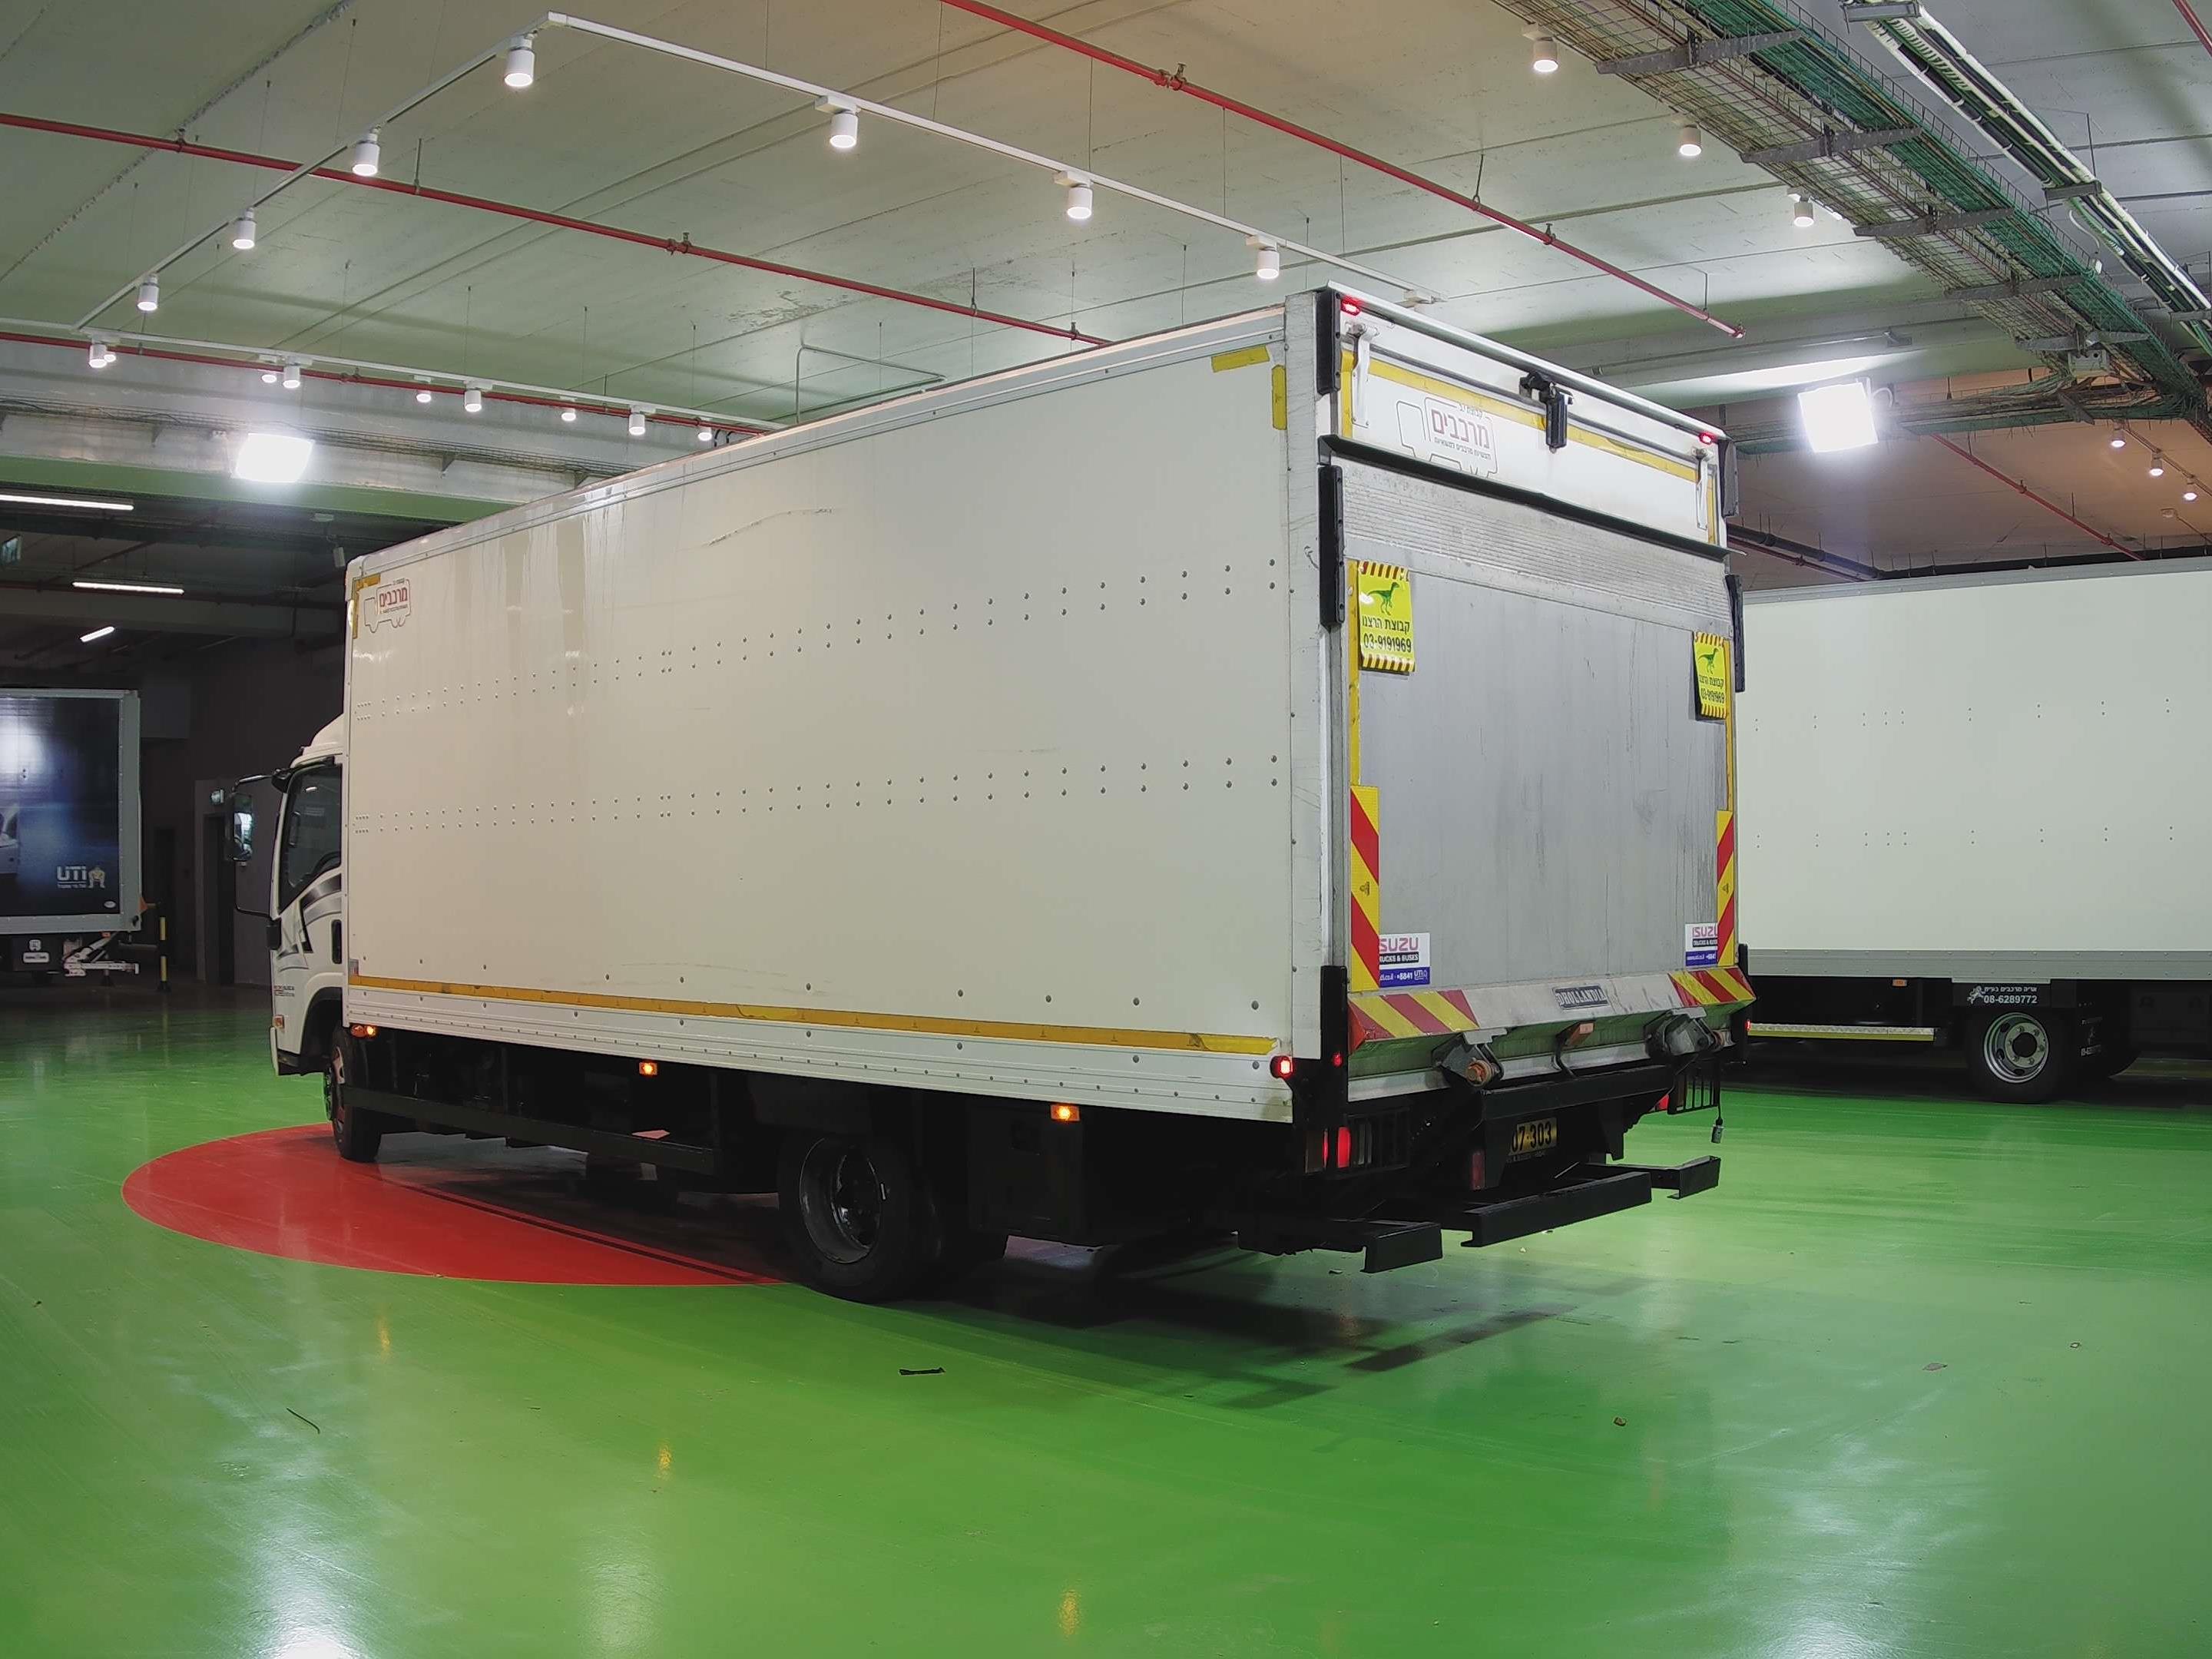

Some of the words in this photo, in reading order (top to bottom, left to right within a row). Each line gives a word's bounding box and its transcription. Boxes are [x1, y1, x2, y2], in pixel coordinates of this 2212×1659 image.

[1431, 409, 1490, 449] מרכבים
[379, 587, 408, 608] מרכבים
[1385, 618, 1410, 635] קבוצת
[1363, 632, 1412, 653] 03-9191969
[1379, 937, 1419, 952] SUZU
[1983, 995, 2038, 1004] 08-6289772
